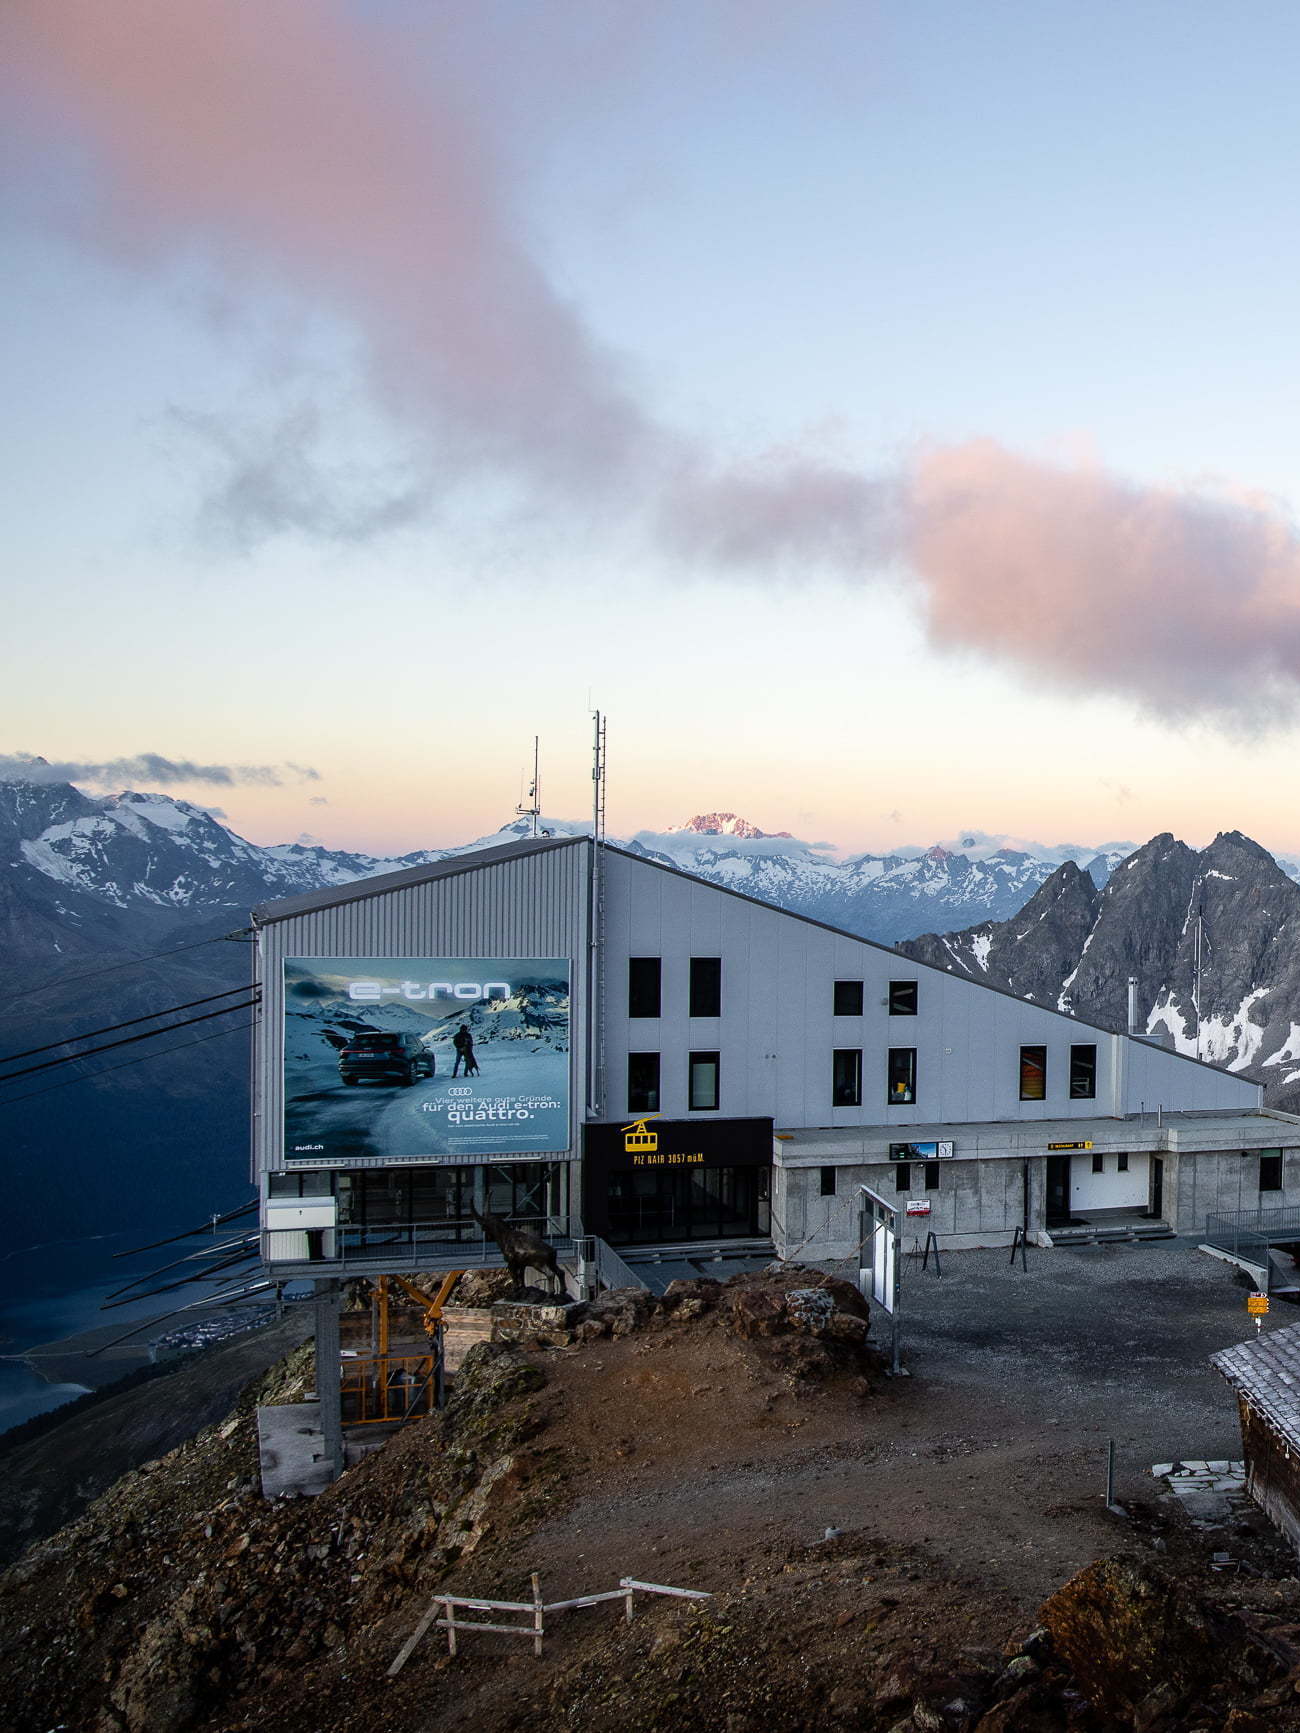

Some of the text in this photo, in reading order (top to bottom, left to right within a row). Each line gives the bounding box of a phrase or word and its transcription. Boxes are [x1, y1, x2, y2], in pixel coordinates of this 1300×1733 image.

[349, 982, 511, 999] e-tron
[422, 1101, 561, 1112] für den Audi e-tron:
[447, 1109, 535, 1124] quattro.
[633, 1155, 645, 1165] PIZ
[647, 1154, 665, 1164] NAIR
[668, 1153, 685, 1164] 3057
